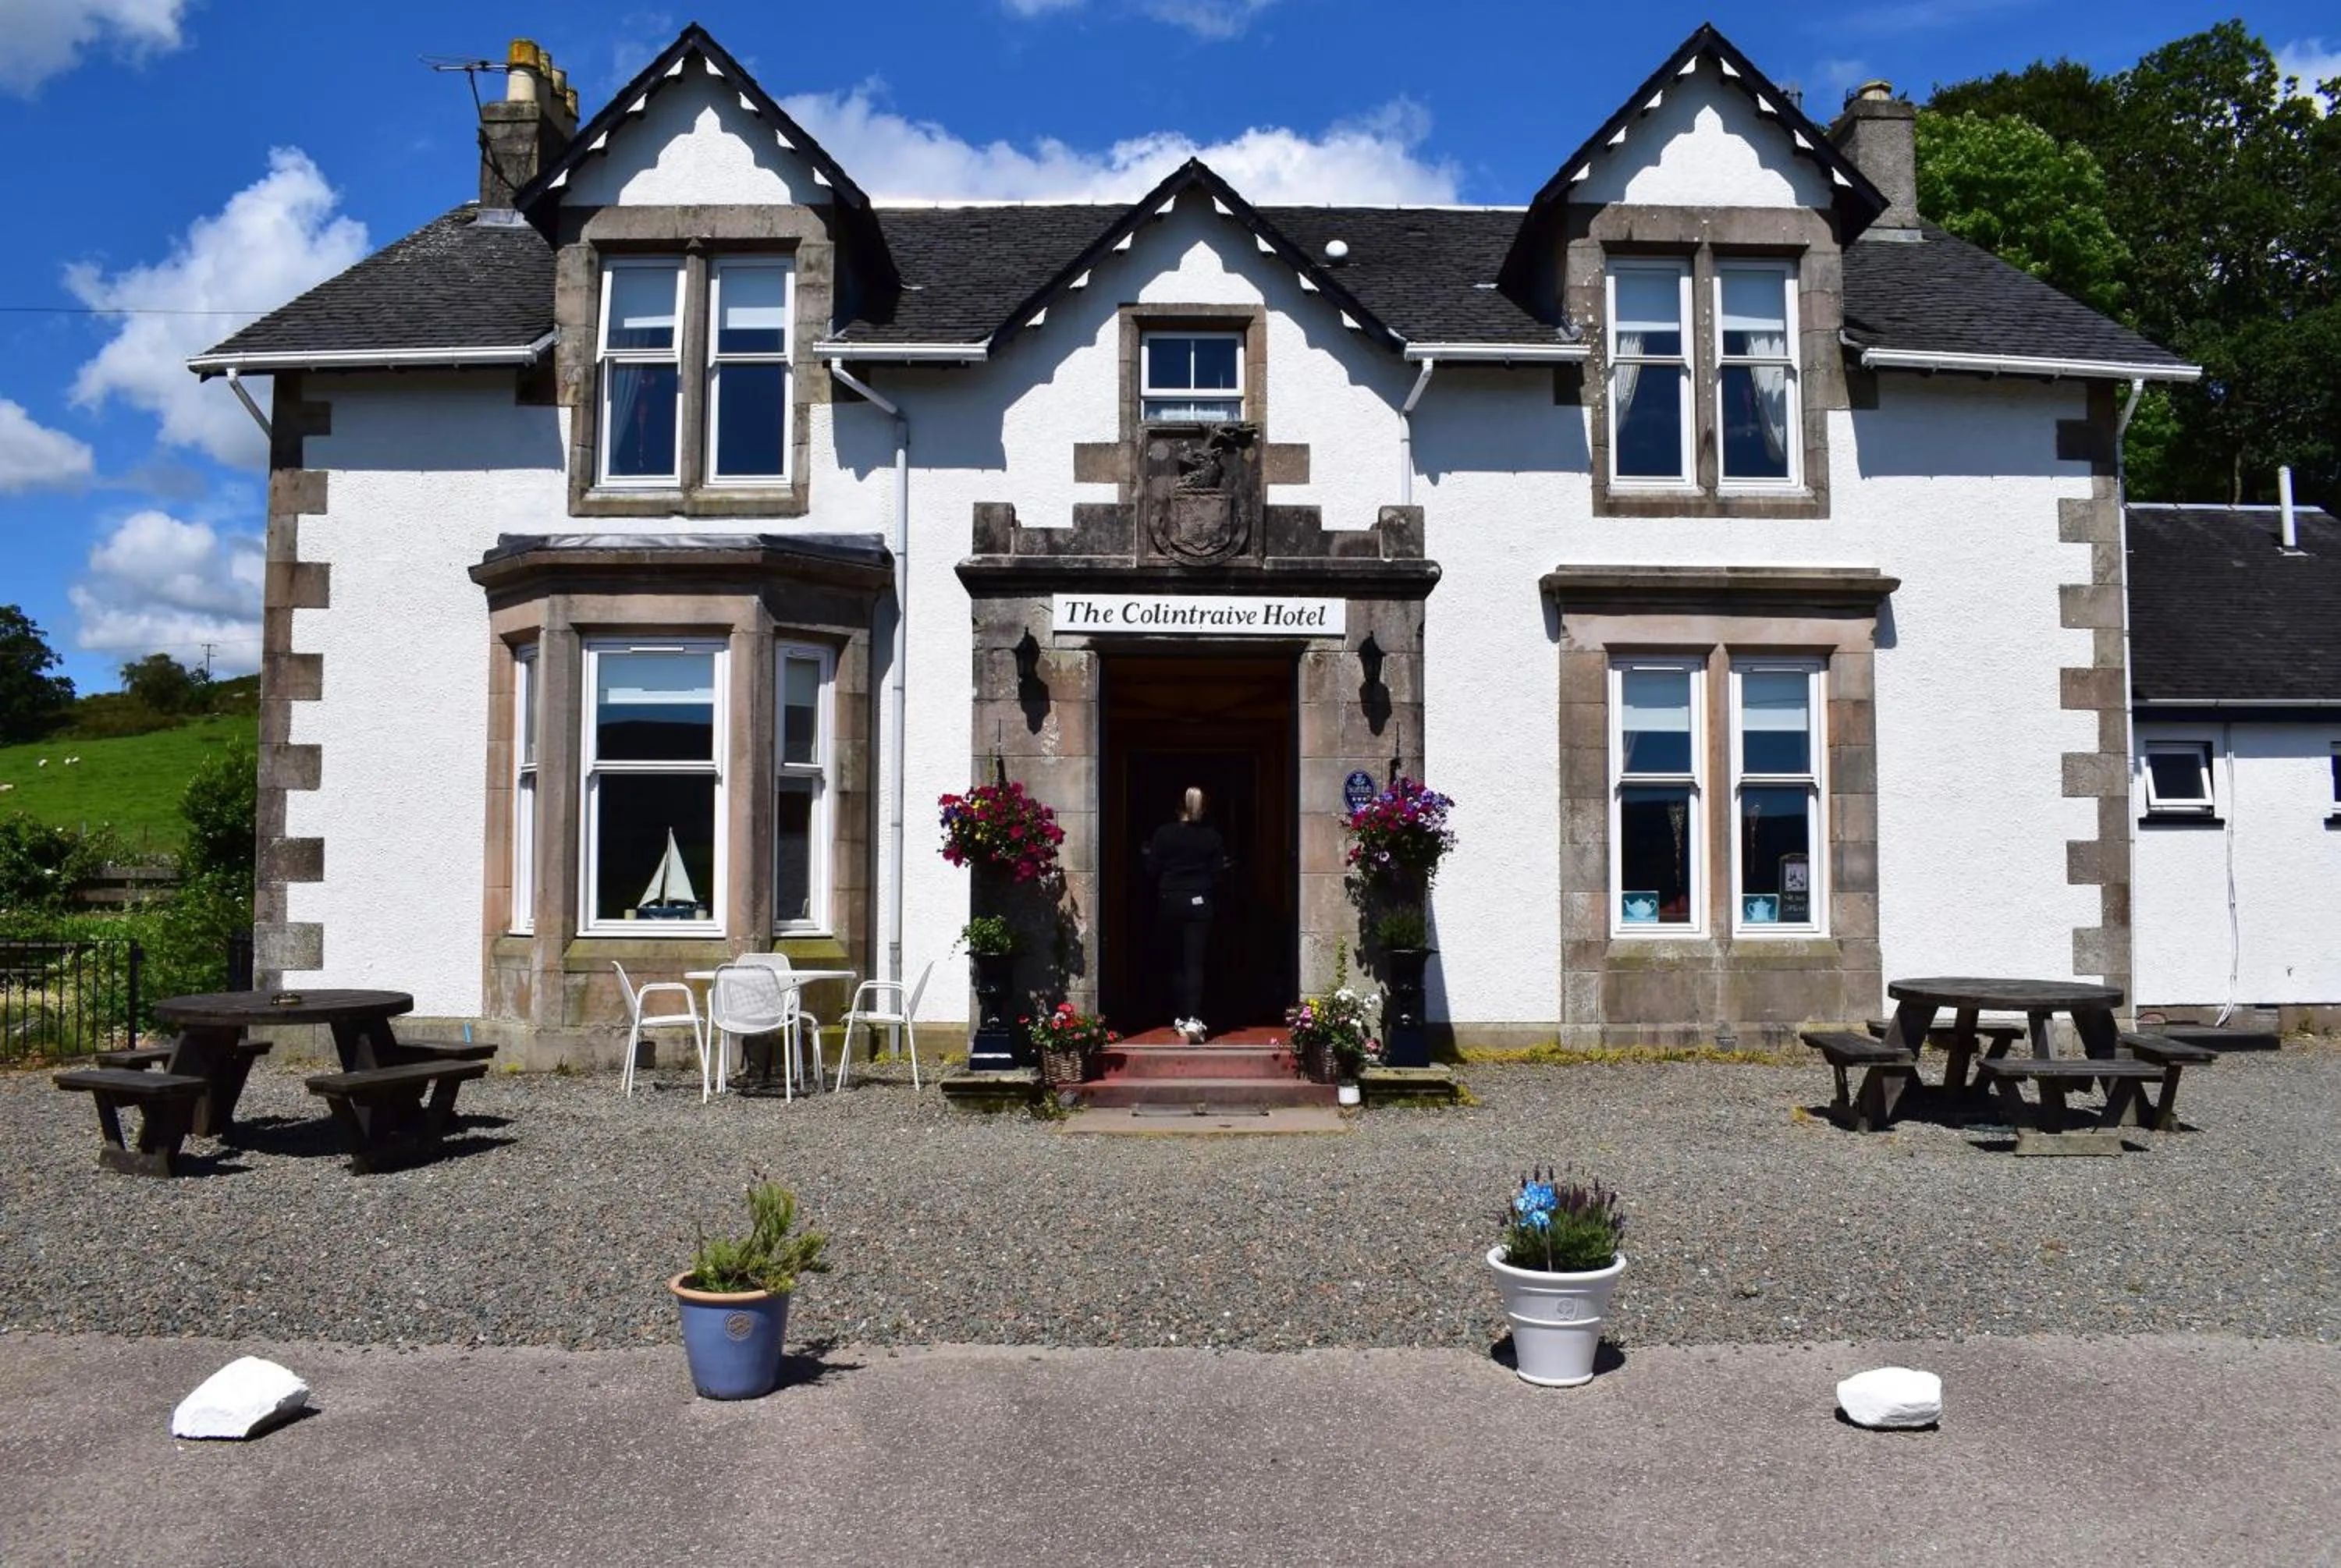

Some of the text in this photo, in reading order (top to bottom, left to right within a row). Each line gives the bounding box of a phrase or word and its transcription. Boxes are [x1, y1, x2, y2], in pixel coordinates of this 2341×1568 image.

[1065, 601, 1326, 626] The Colintraive Hotel
